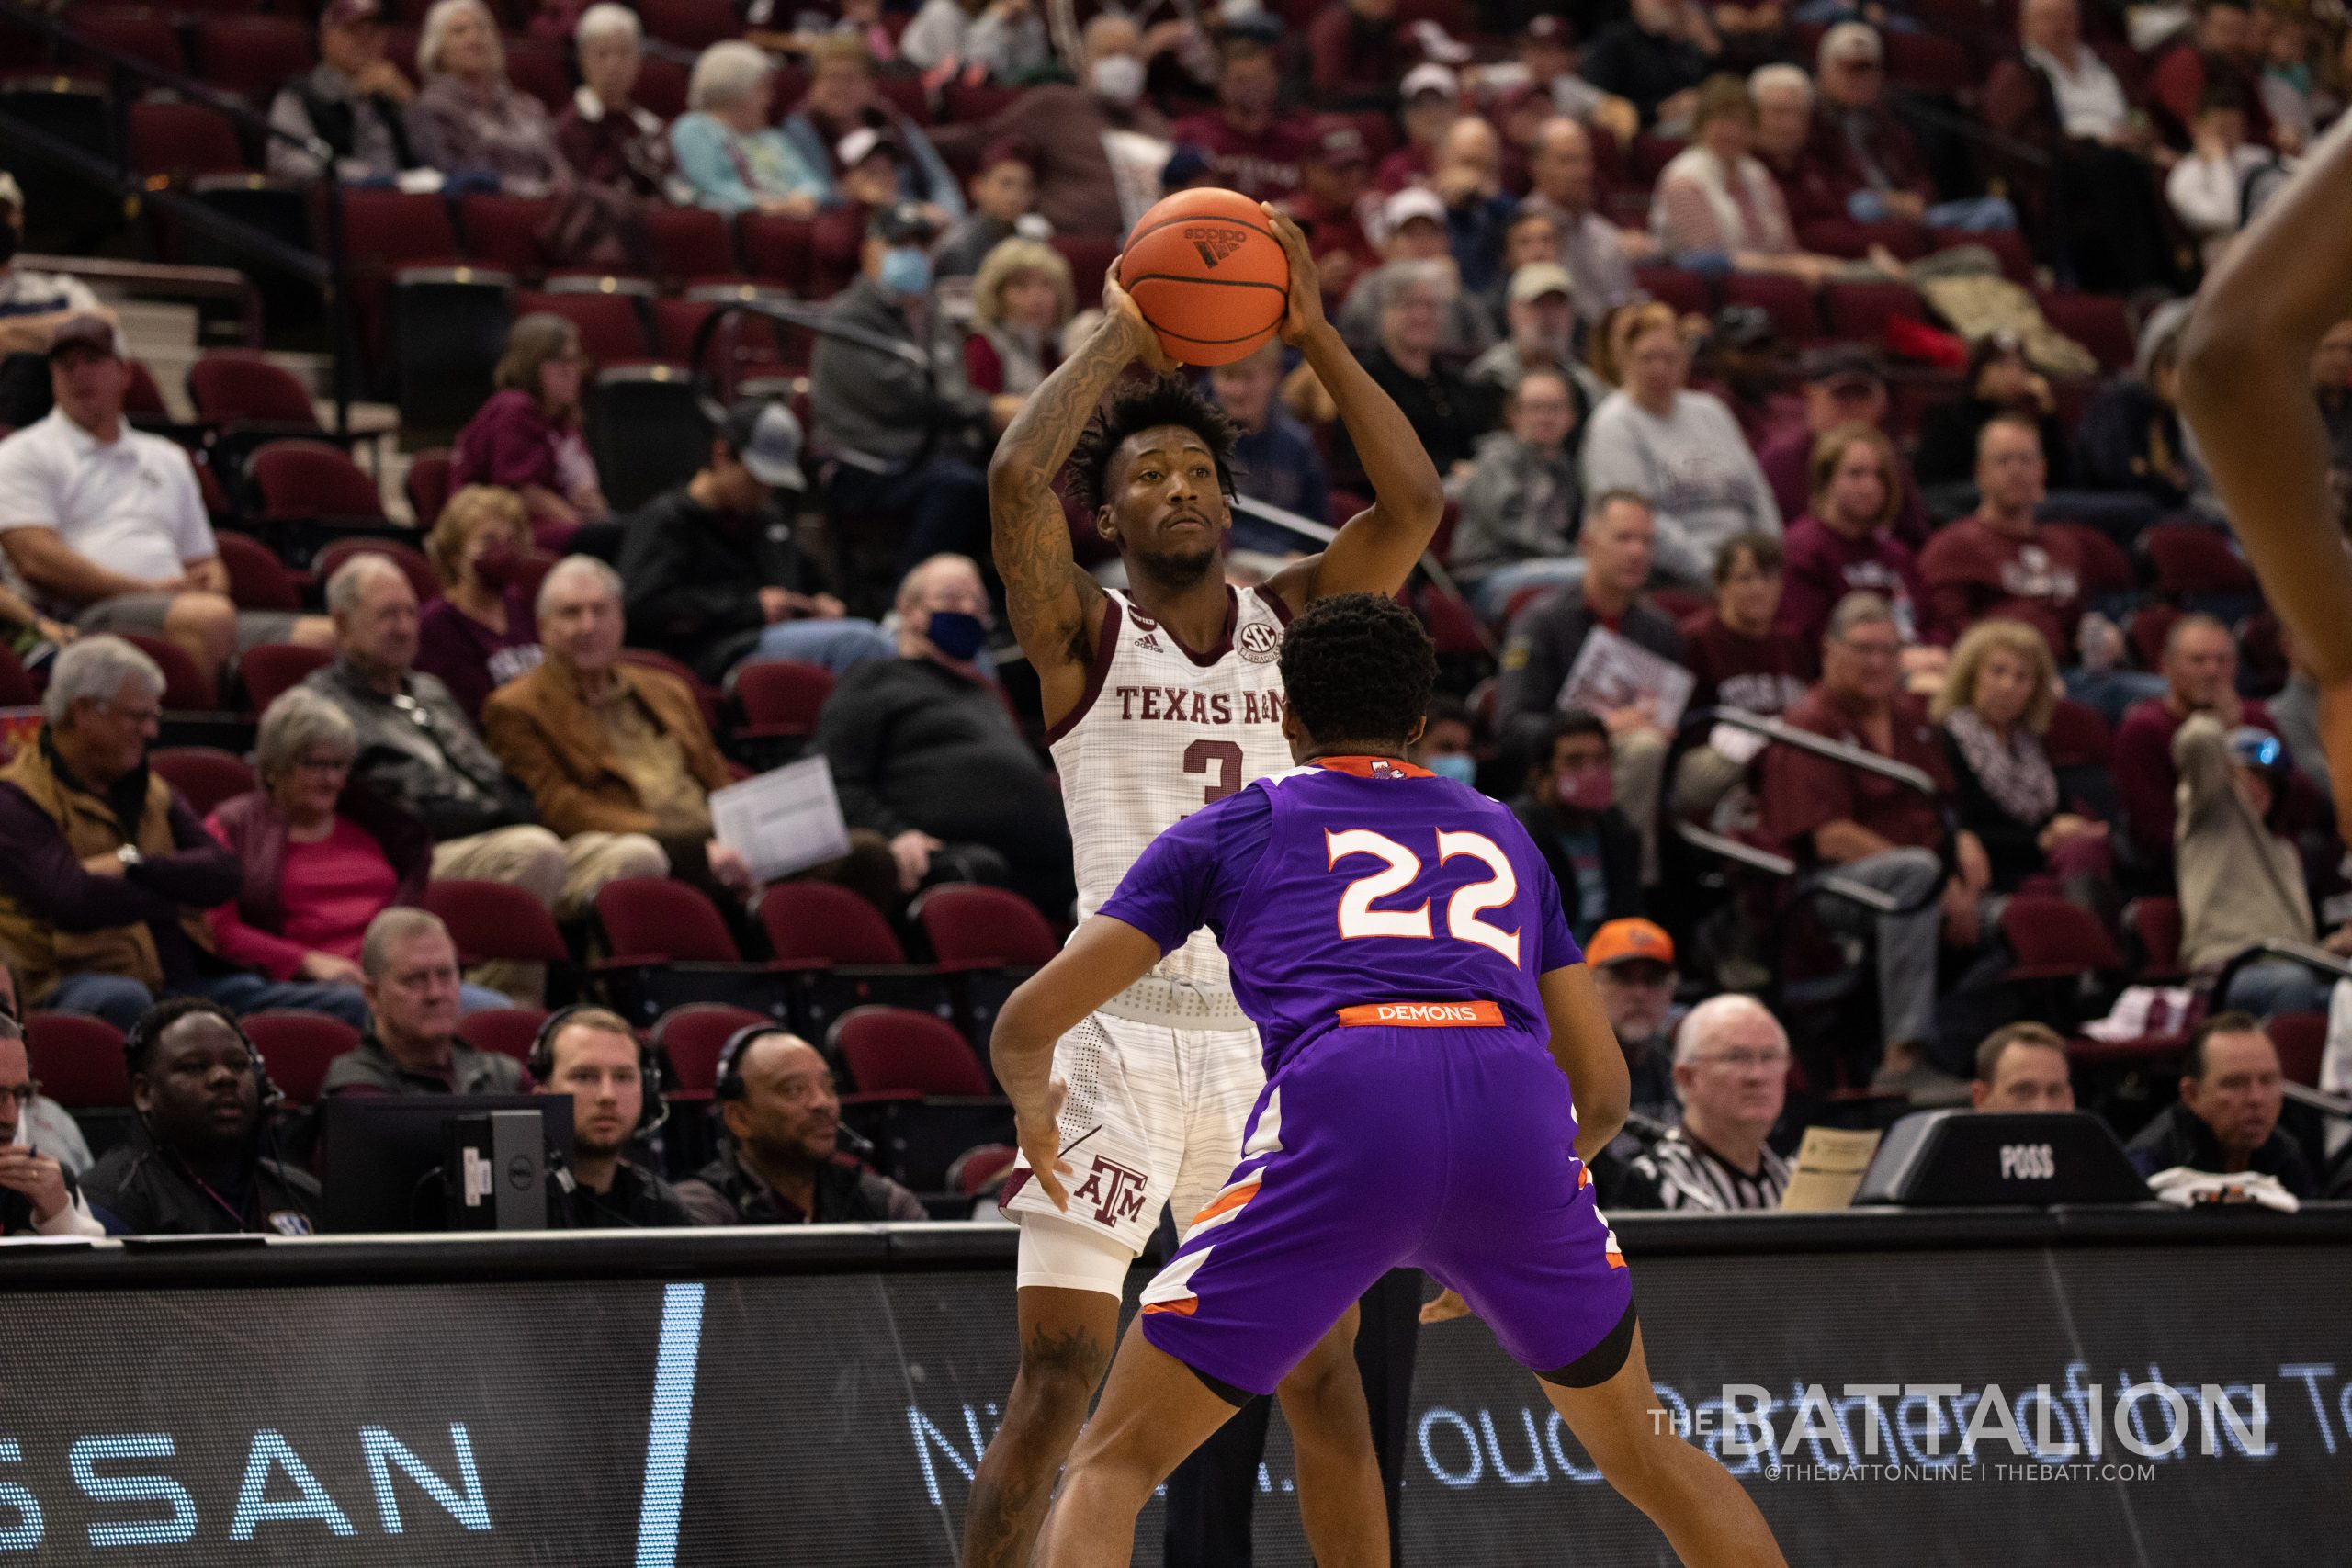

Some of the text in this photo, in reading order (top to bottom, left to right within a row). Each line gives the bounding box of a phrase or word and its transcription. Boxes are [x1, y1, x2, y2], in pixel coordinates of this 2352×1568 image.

[1134, 640, 1164, 654] adidas
[1241, 623, 1277, 653] SEC
[1116, 685, 1233, 725] TEXAS
[1181, 739, 1244, 821] 3
[1324, 826, 1521, 972] 22
[1377, 1004, 1477, 1023] DEMONS
[1999, 1144, 2055, 1180] POSS
